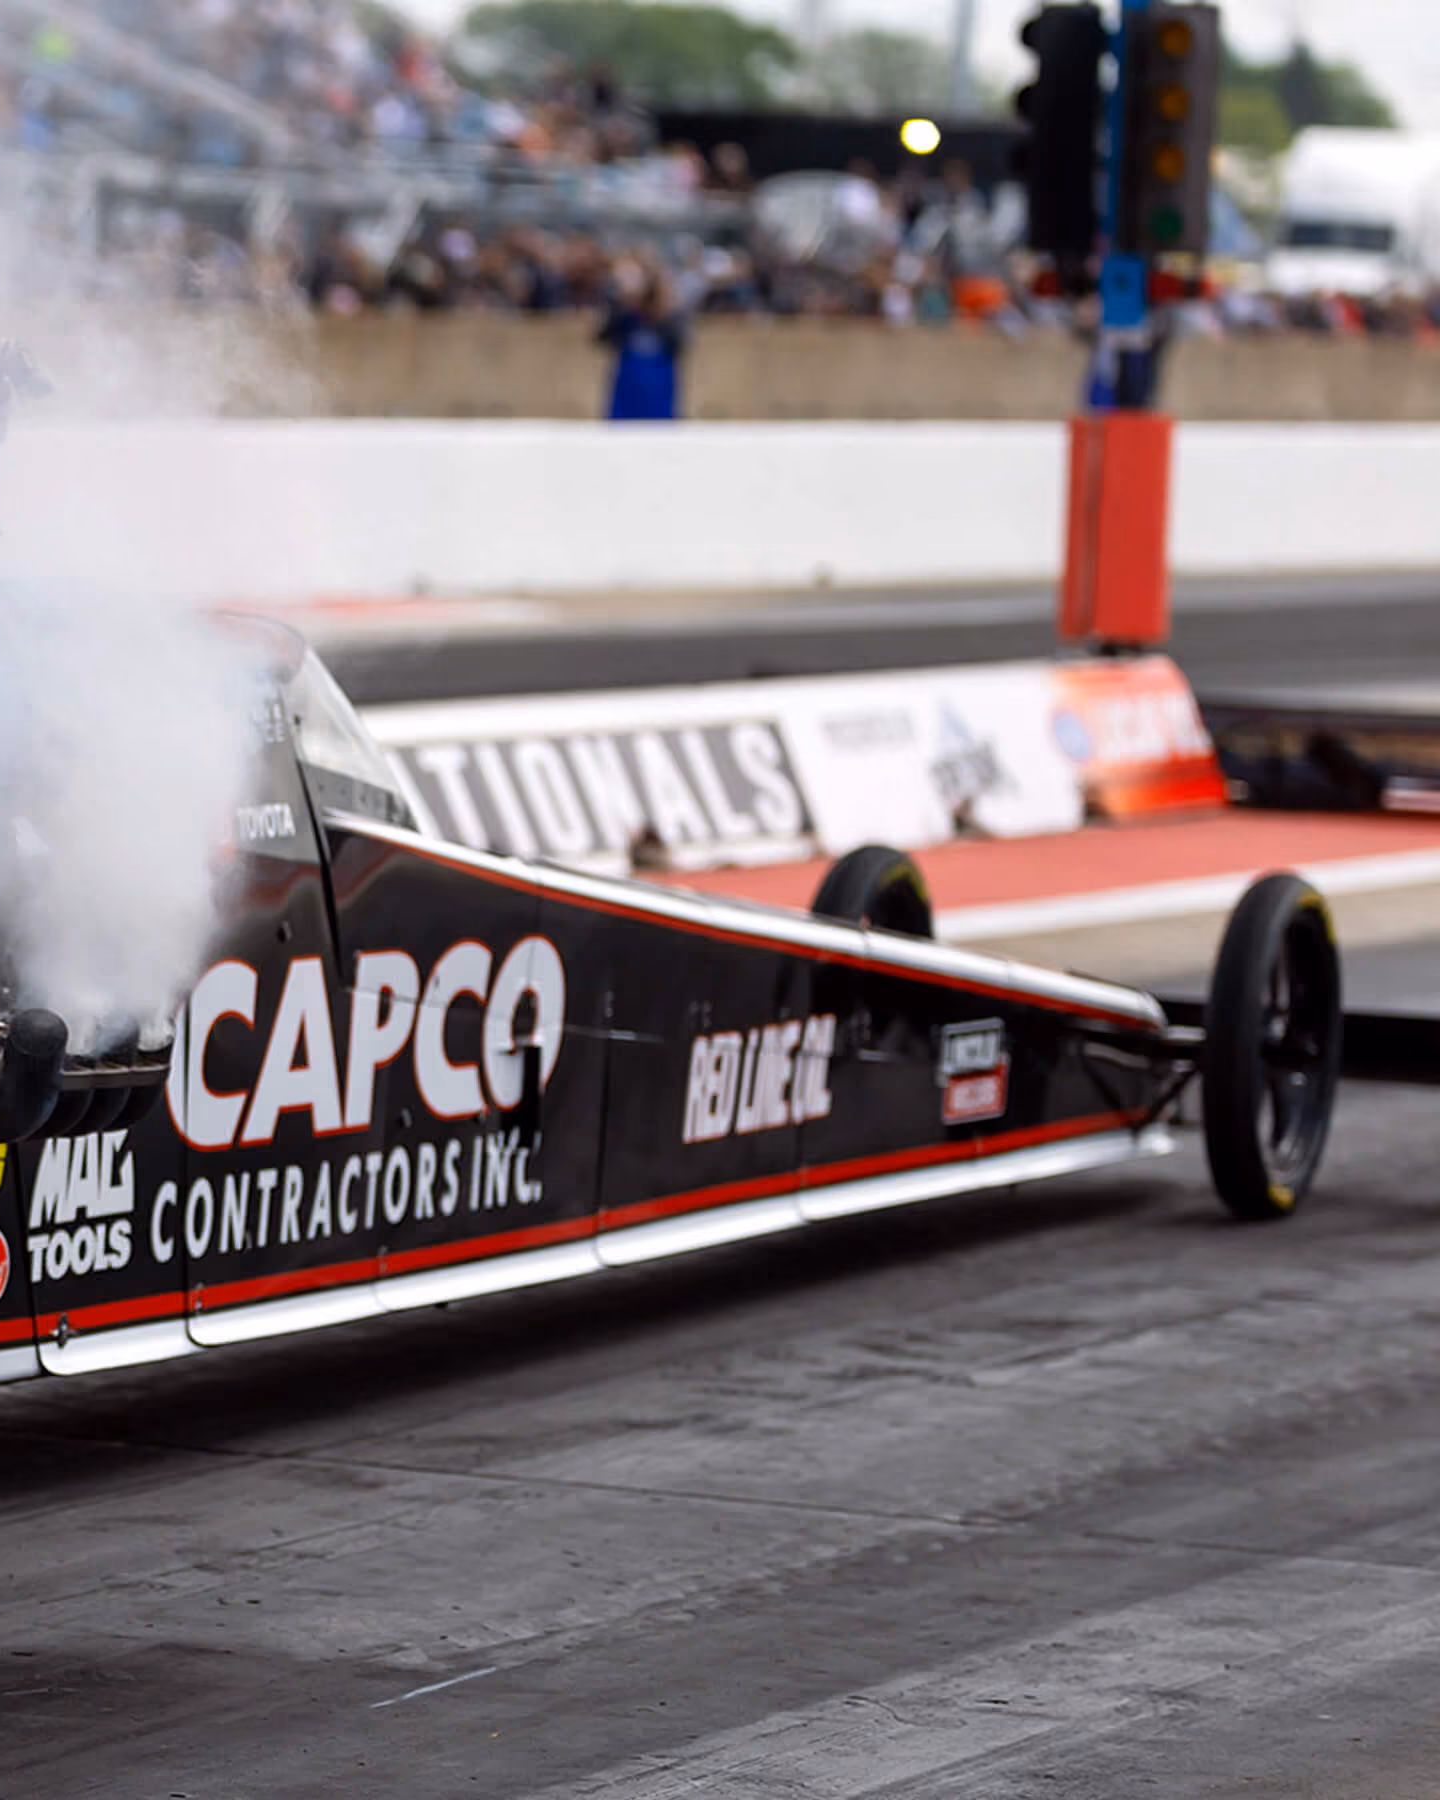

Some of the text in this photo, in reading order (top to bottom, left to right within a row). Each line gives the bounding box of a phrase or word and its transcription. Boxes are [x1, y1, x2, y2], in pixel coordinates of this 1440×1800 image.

[237, 803, 295, 840] TOYOTA
[166, 934, 566, 1152] CAPCO
[28, 1129, 134, 1229] MAC
[151, 1138, 461, 1263] CONTRACTORS
[27, 1219, 132, 1283] TOOLS
